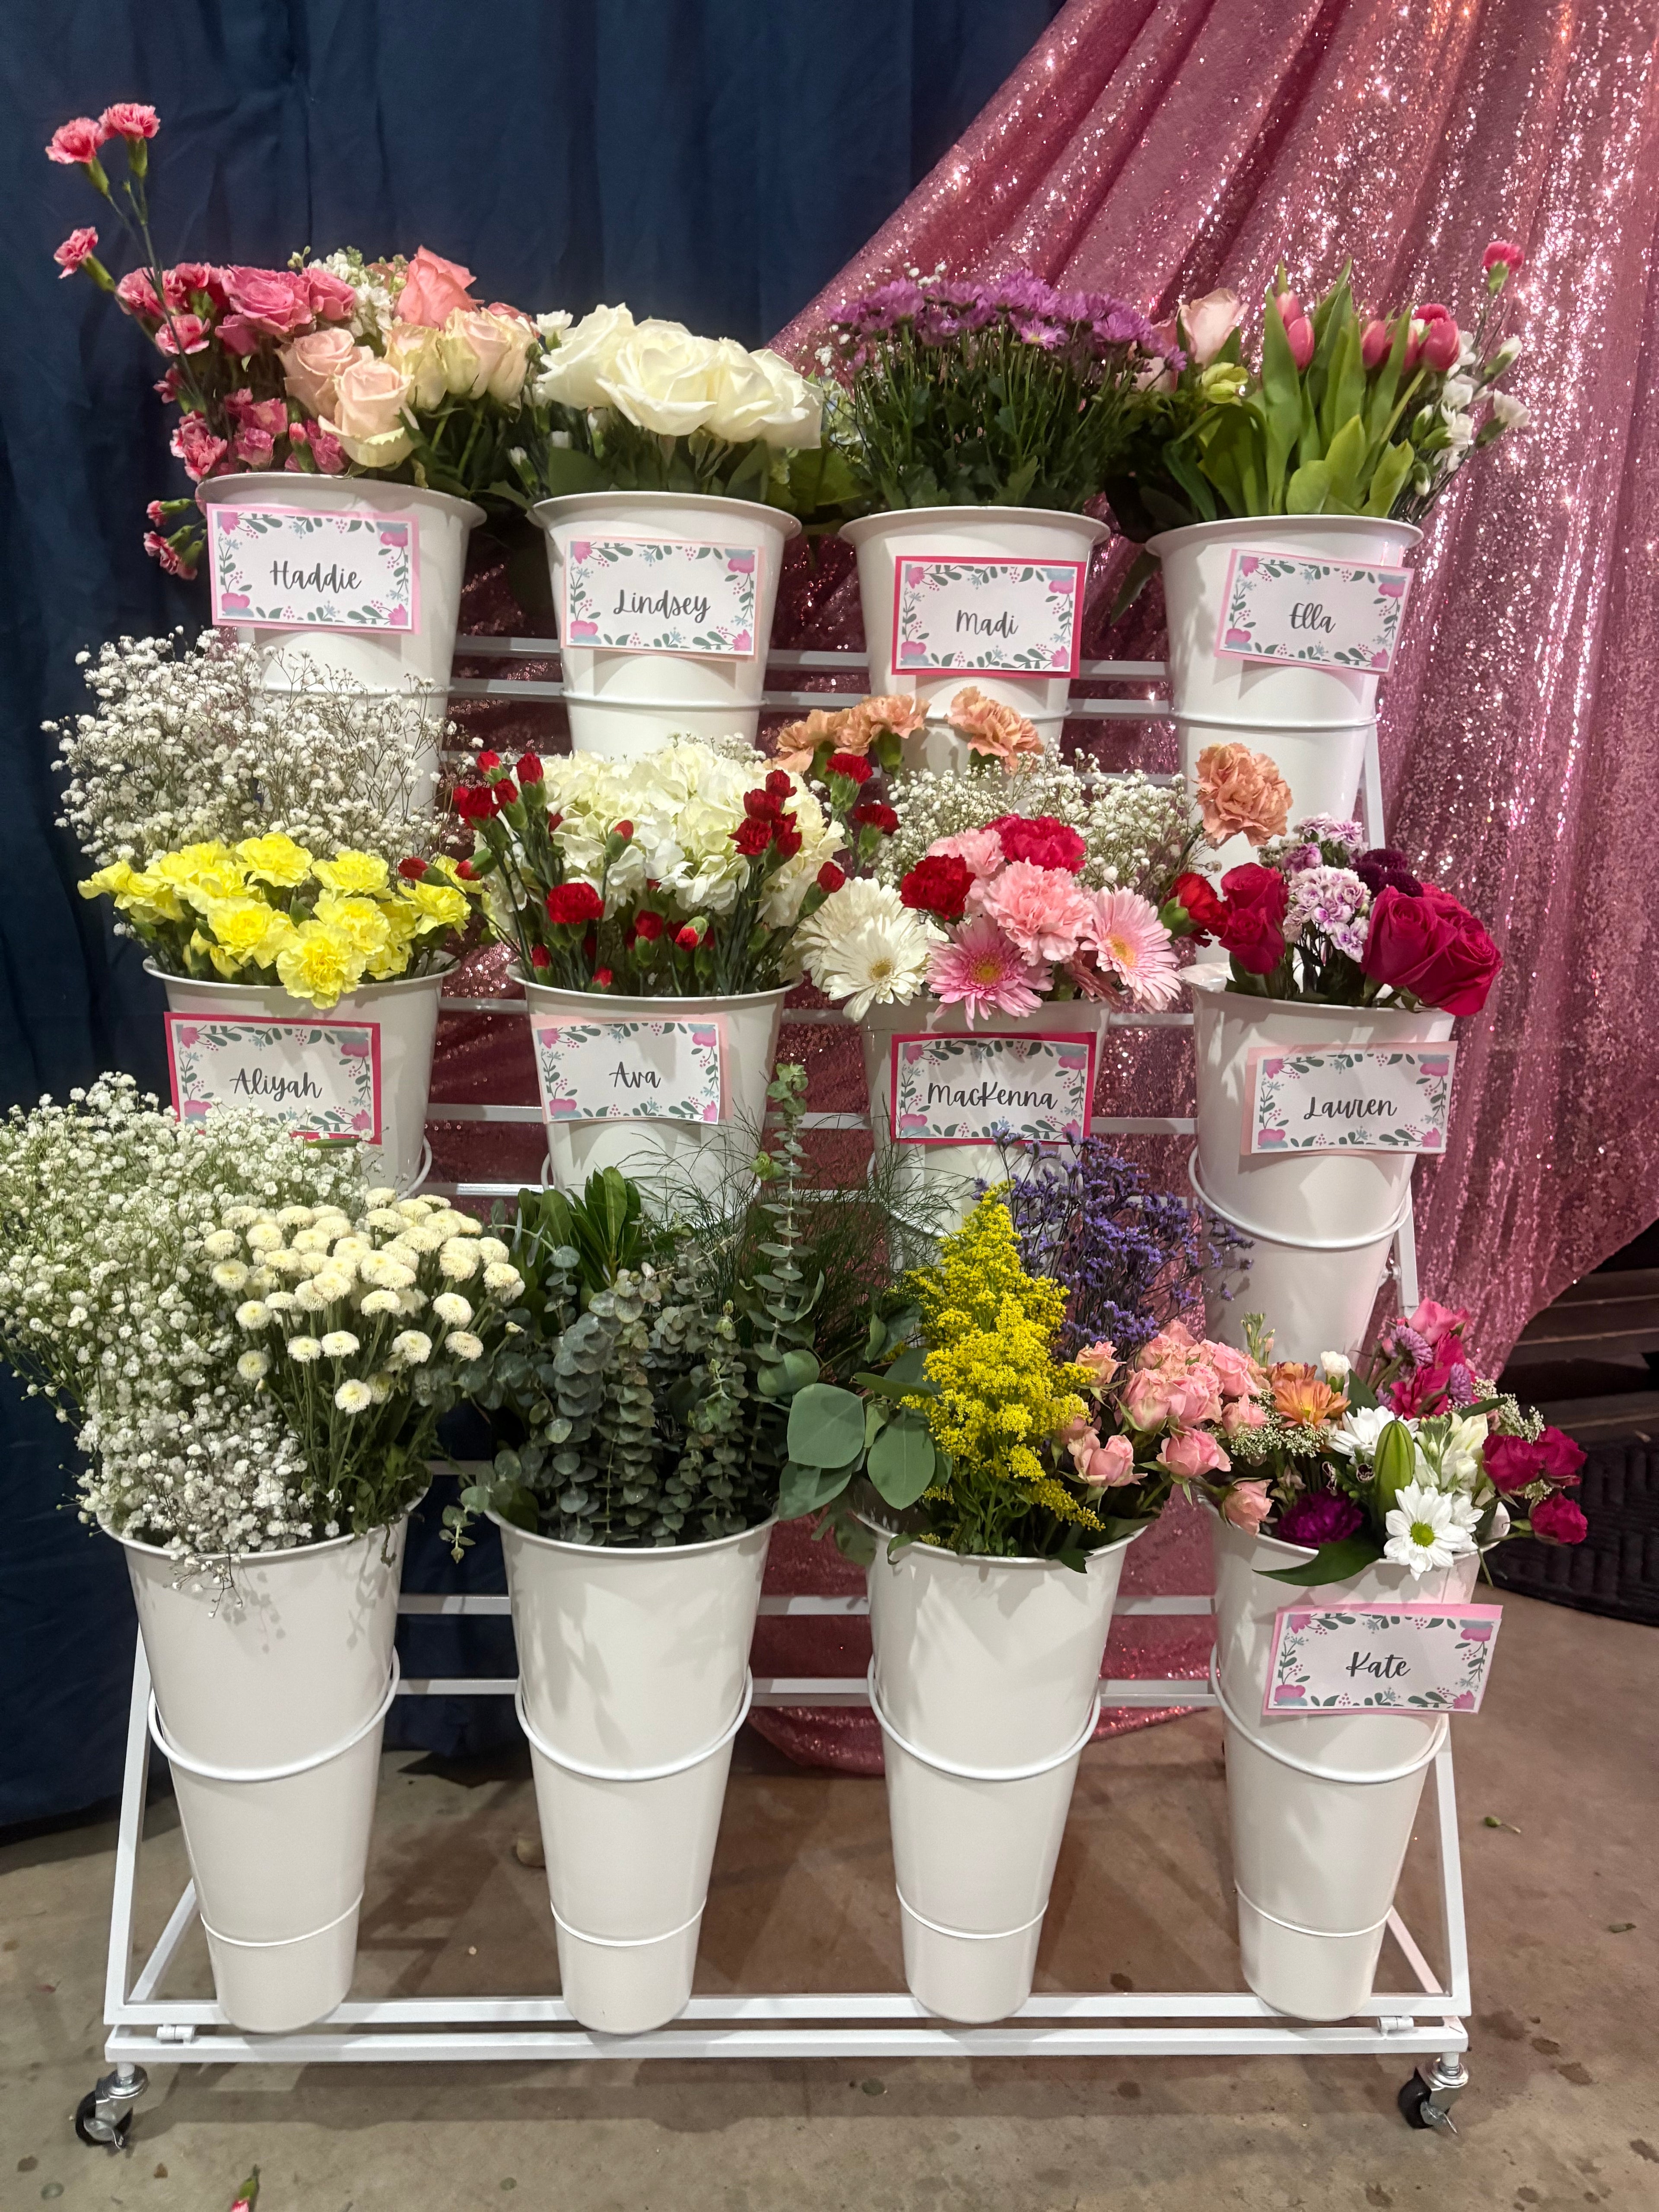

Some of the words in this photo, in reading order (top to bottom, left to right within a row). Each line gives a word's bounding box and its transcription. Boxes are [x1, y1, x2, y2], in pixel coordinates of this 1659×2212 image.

[270, 561, 362, 593] Haddie
[613, 590, 711, 623] Lindsey
[1290, 603, 1336, 633] Ella
[956, 610, 1019, 639] Madi
[229, 1068, 322, 1101] Aliyah
[608, 1062, 661, 1088] Ava
[927, 1081, 1058, 1109] MacKenna
[1303, 1096, 1398, 1120] Lauren
[1345, 1652, 1411, 1678] Kate
